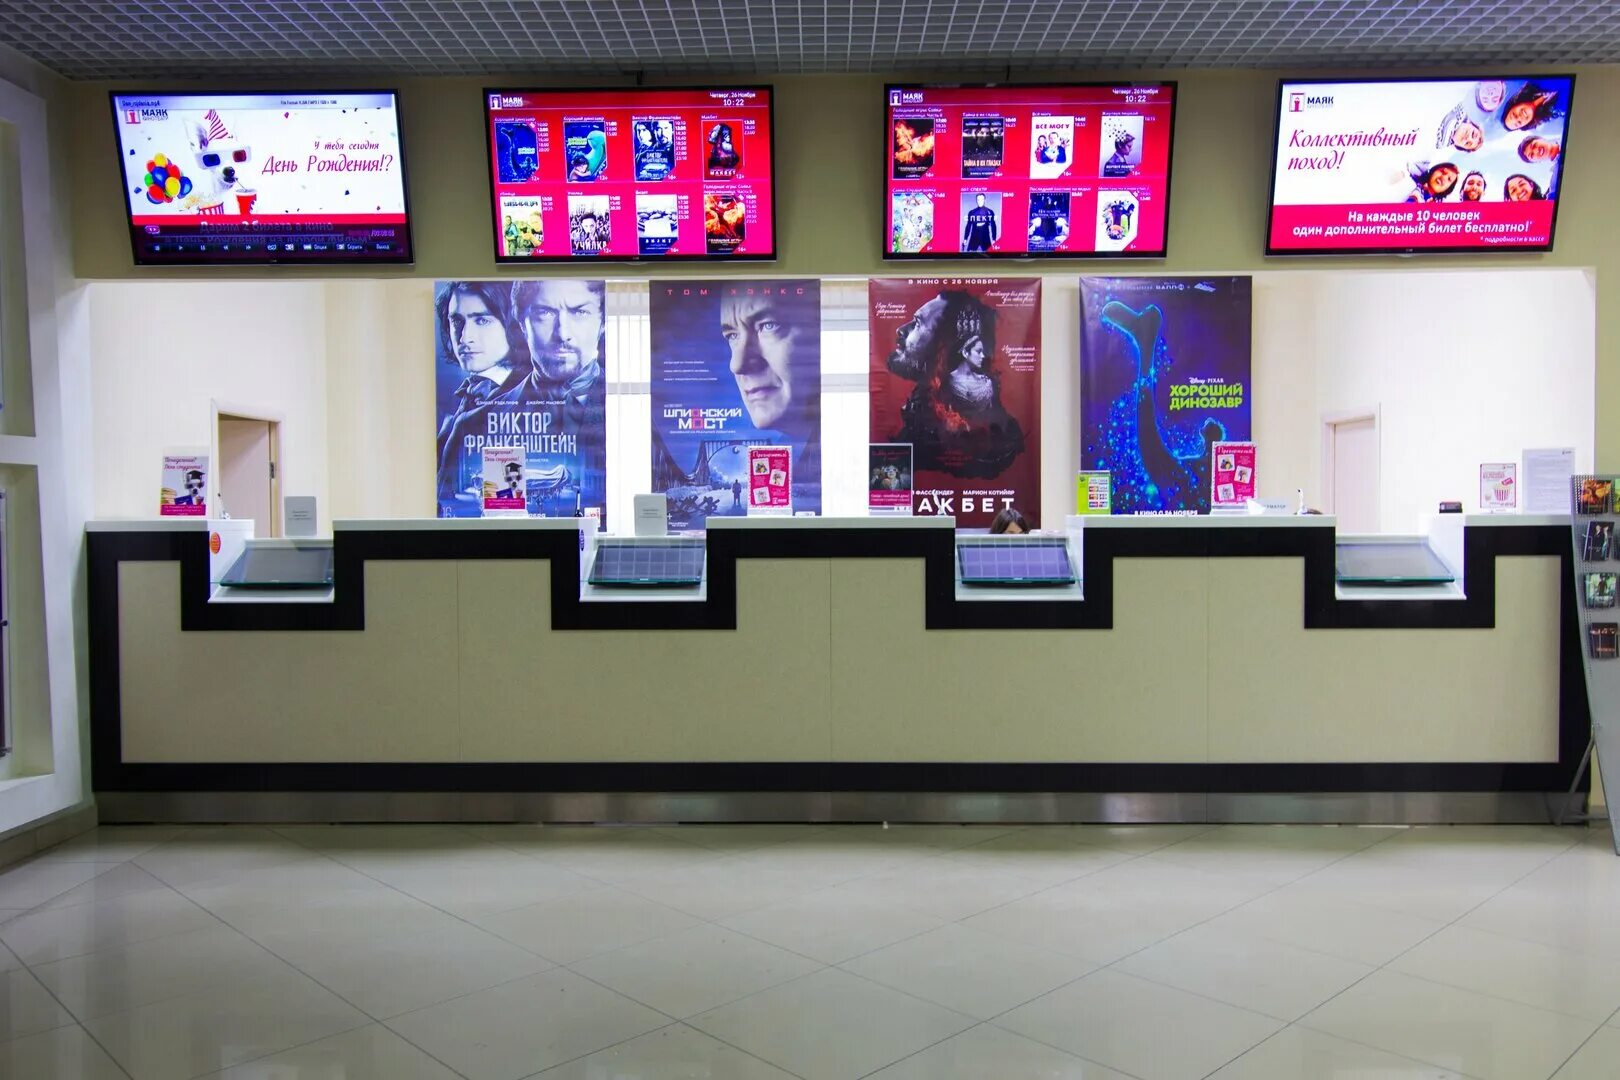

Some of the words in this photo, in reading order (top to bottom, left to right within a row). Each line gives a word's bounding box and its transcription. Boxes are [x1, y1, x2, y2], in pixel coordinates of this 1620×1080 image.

[1307, 96, 1334, 104] МАЯК
[141, 109, 168, 117] МАЯК
[324, 138, 344, 150] тебя
[348, 140, 380, 150] сегодня
[1288, 127, 1418, 148] Коллективный
[262, 156, 298, 175] День
[307, 153, 393, 172] Рождения!?
[1288, 150, 1345, 170] поход!
[1348, 211, 1363, 222] На
[1366, 212, 1413, 224] каждые
[1416, 210, 1430, 221] 10
[1433, 211, 1480, 221] человек
[1293, 226, 1322, 237] один
[1325, 221, 1425, 237] дополнительный
[1428, 220, 1462, 233] билет
[1170, 383, 1243, 397] ХОРОШИЙ
[1170, 397, 1243, 411] ДИНОЗАВР
[663, 407, 742, 418] ШПИОНСКИЙ
[487, 412, 551, 434] ВИКТОР
[678, 417, 728, 430] МОСТ
[464, 432, 577, 456] ФРАНКЕНШТЕЙН
[988, 488, 1015, 496] КОТИЙЯР
